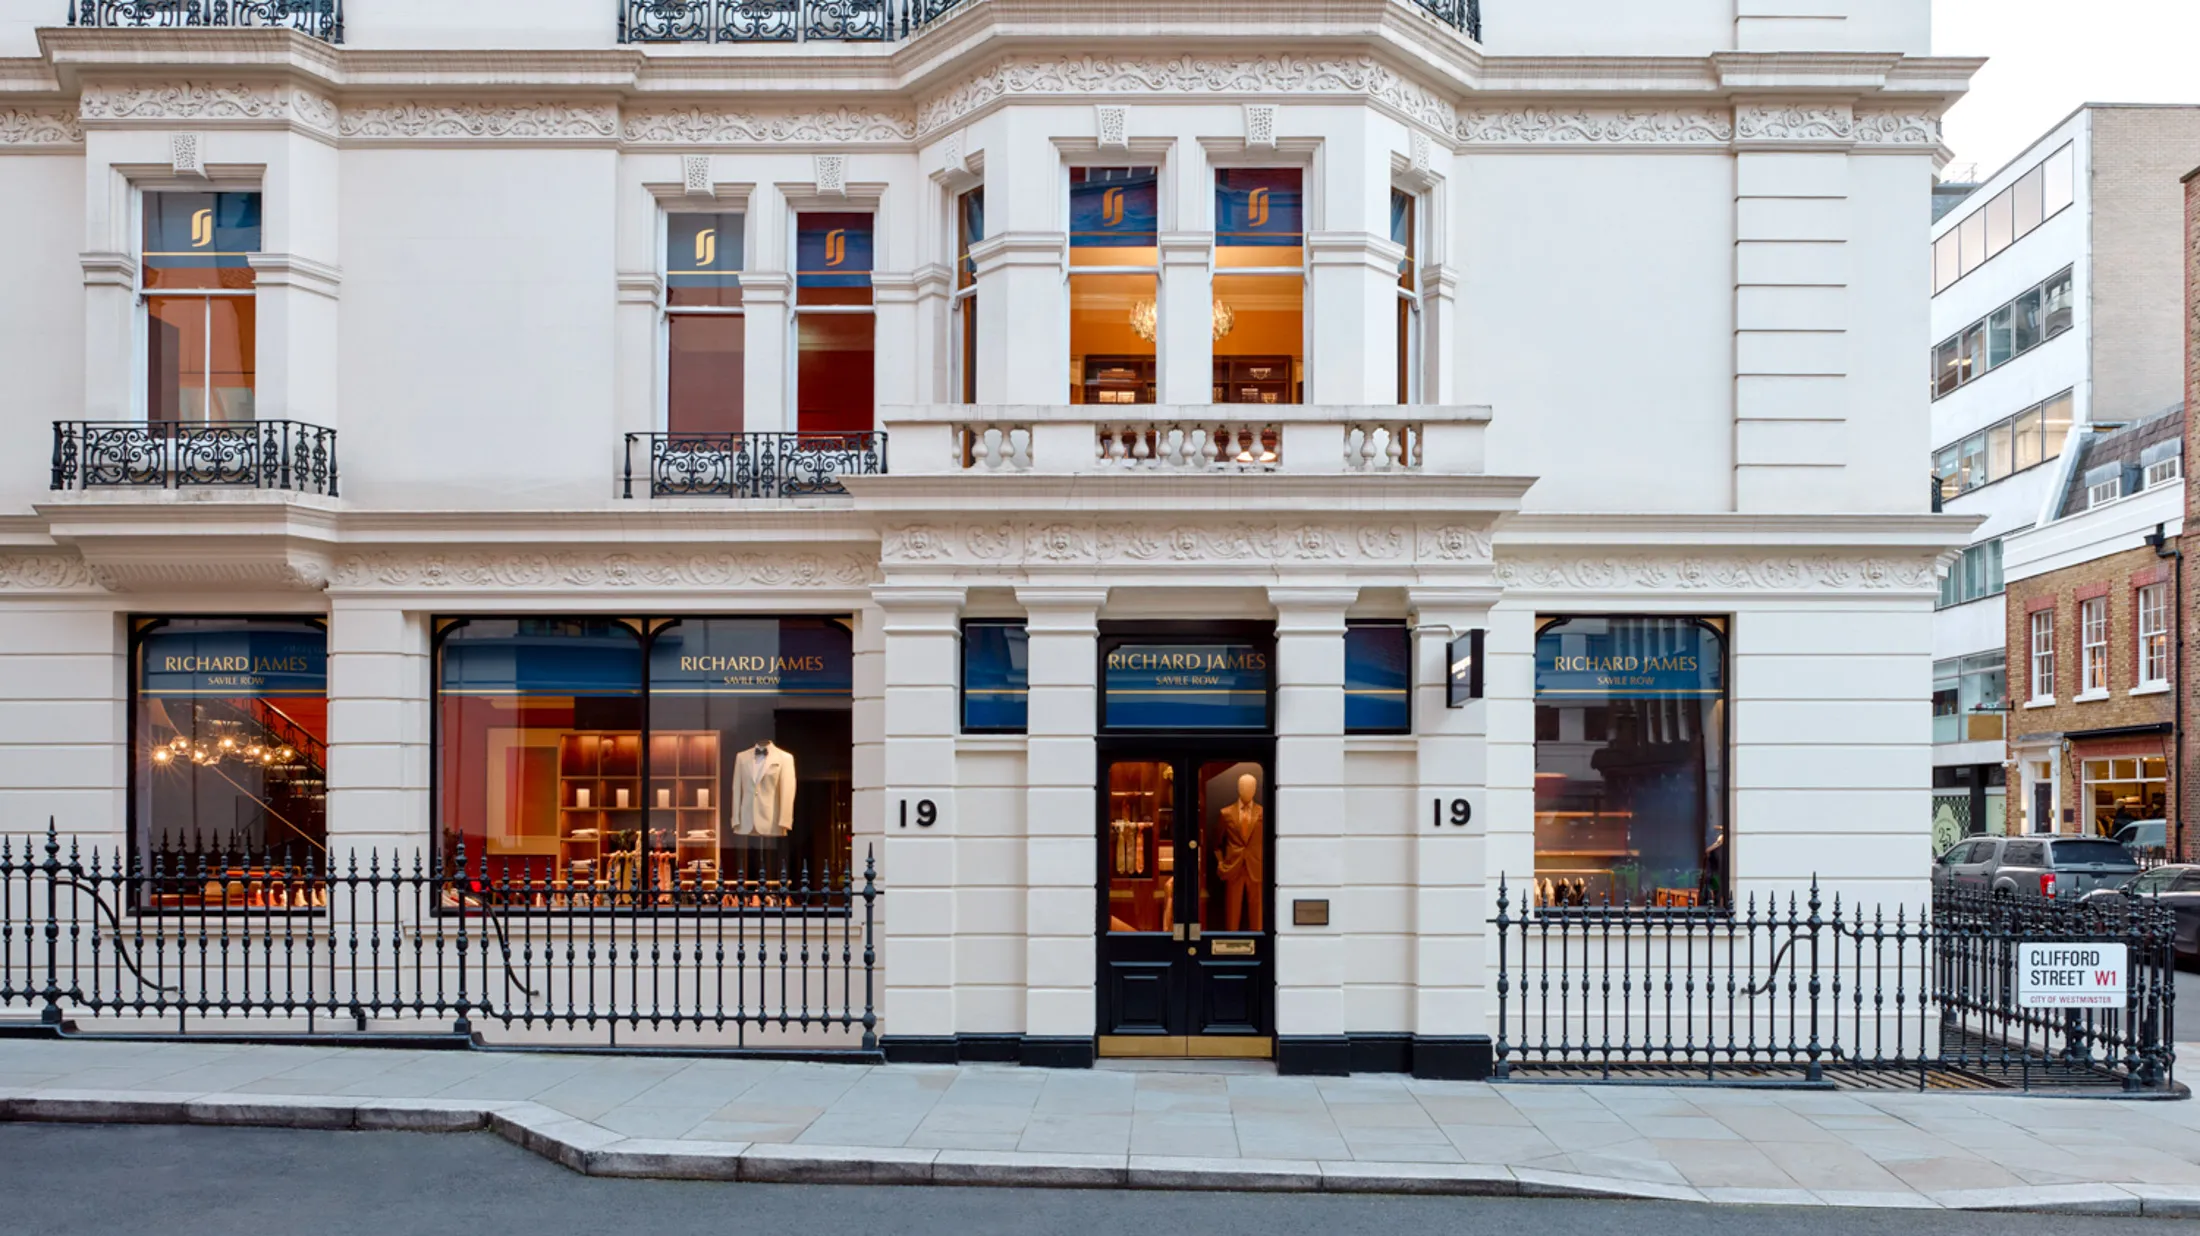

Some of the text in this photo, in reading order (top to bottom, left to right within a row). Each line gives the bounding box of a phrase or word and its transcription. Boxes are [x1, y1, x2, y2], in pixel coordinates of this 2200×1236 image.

[165, 656, 307, 673] RICHARD JAMES
[681, 656, 824, 674] RICHARD JAMES
[1108, 653, 1266, 673] RICHARD JAMES
[1554, 656, 1698, 674] RICHARD JAMES
[208, 676, 265, 685] SAVILE ROW
[724, 676, 781, 685] SAVILE ROW
[1156, 676, 1220, 685] SAVILE ROW
[1597, 676, 1655, 685] SAVILE ROW
[900, 799, 937, 828] 19
[1434, 798, 1471, 827] 19
[2030, 950, 2100, 967] CLIFFORD
[2030, 970, 2117, 986] STREET W1
[2030, 996, 2112, 1004] CITY OF WESTMINSTER
